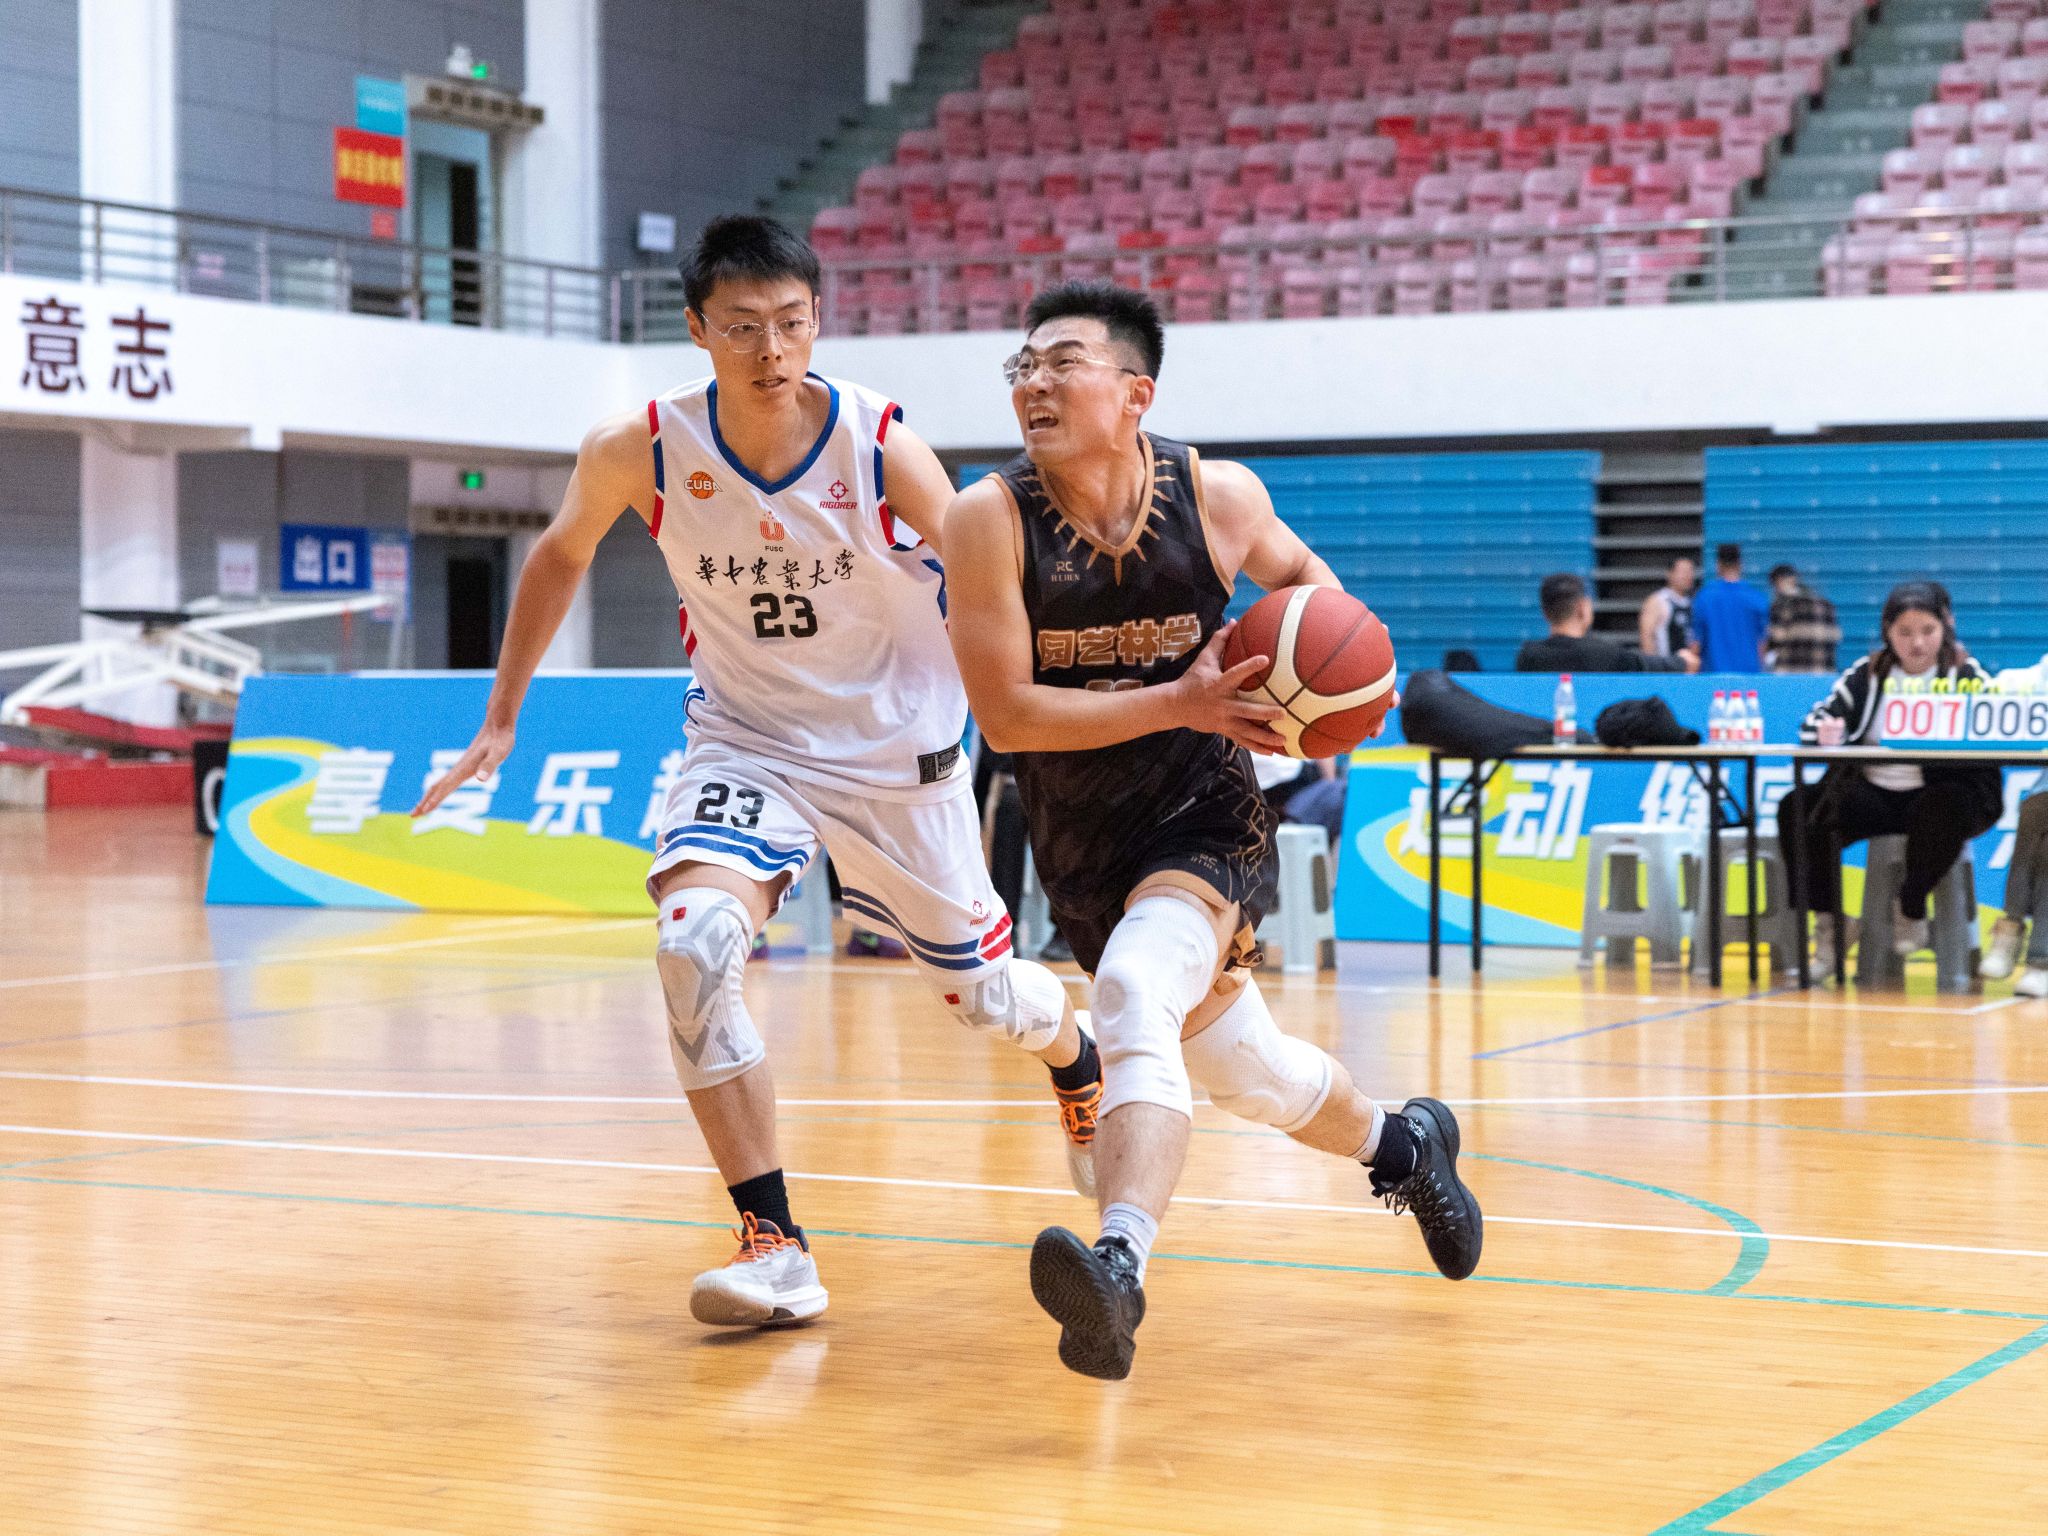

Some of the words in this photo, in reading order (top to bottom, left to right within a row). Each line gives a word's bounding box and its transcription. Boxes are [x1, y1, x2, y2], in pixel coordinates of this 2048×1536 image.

[21, 297, 172, 398] 意志
[684, 478, 724, 492] CUBA
[819, 500, 858, 510] RIGORER
[750, 592, 818, 638] 23
[1037, 612, 1201, 671] 园艺林学
[1885, 699, 1962, 736] 007
[1972, 701, 2048, 737] 006
[694, 782, 765, 829] 23
